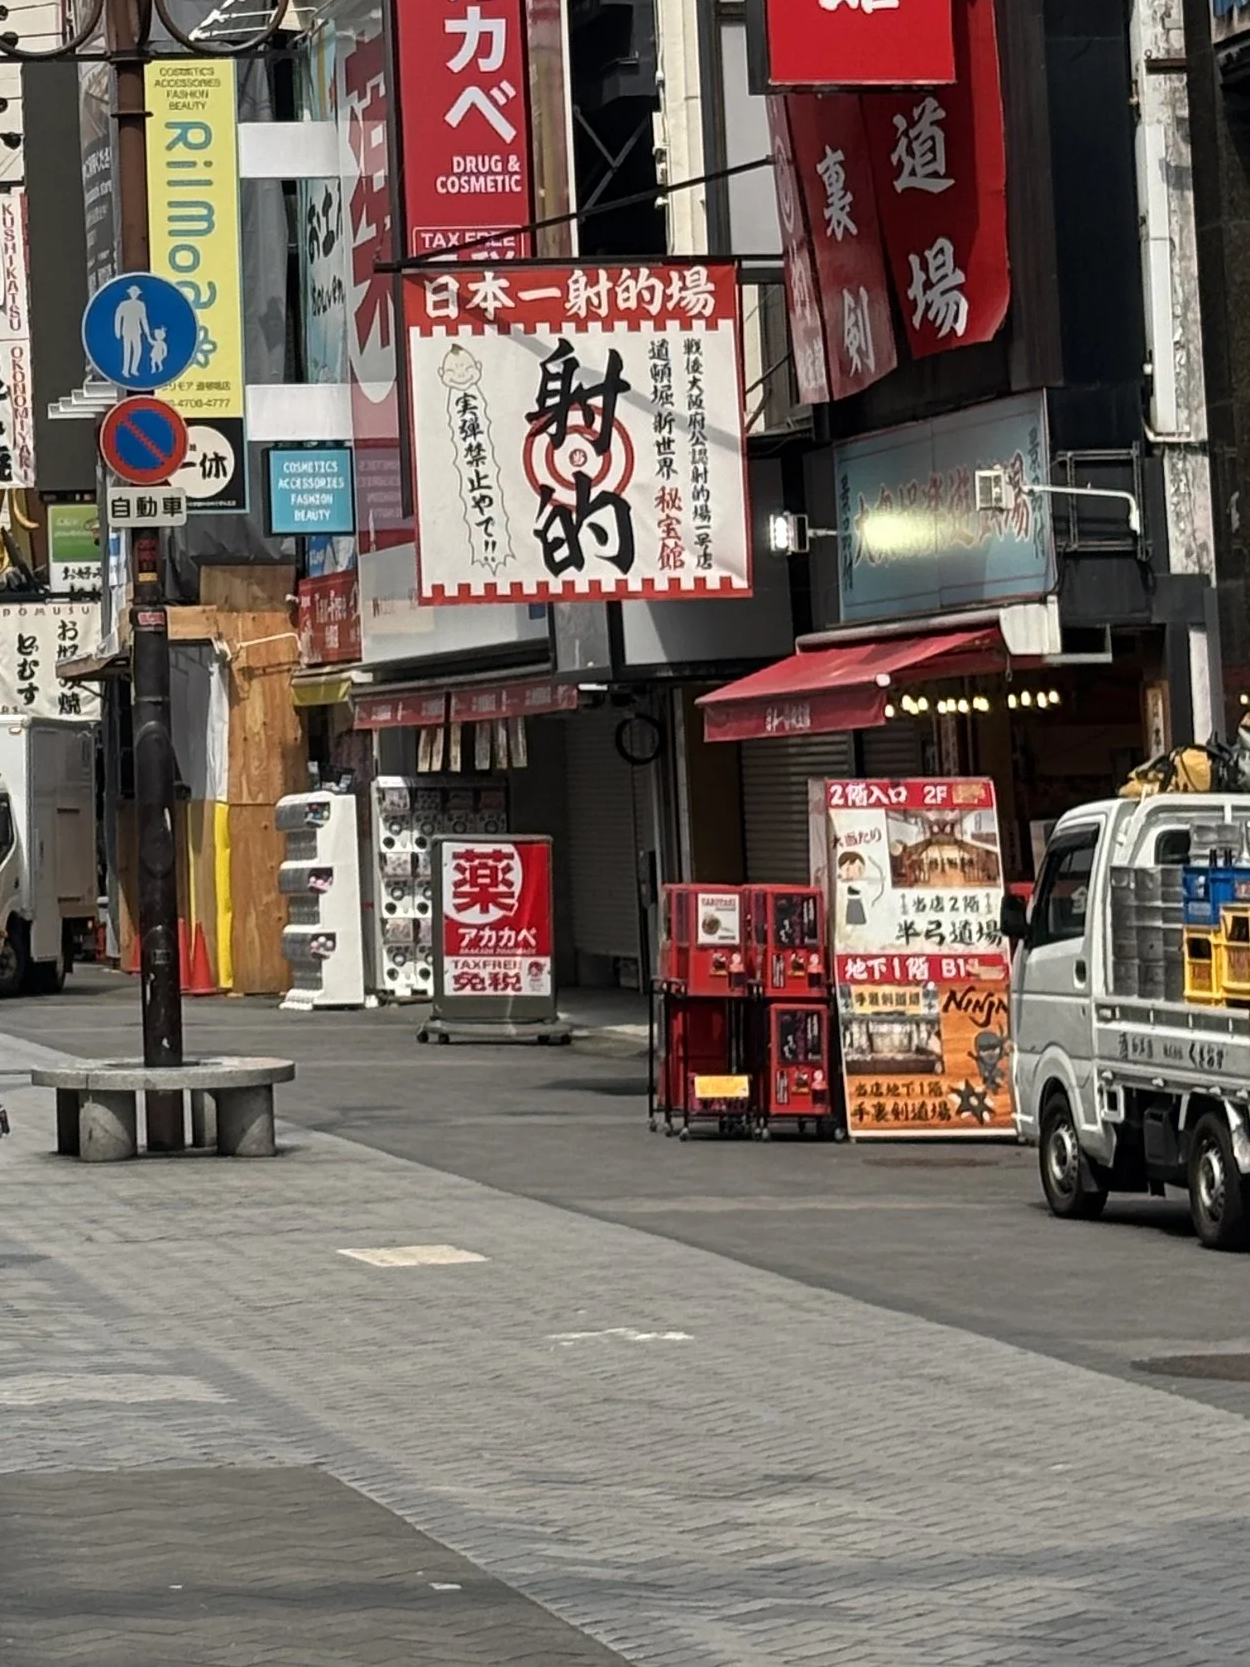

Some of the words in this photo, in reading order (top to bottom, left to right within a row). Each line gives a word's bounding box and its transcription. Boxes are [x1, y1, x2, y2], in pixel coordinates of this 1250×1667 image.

[166, 89, 209, 99] FASHION
[168, 101, 207, 110] BEAUTY
[452, 155, 502, 173] DRUG
[507, 154, 521, 172] &
[436, 174, 522, 194] COSMETIC
[890, 96, 969, 340] 道場
[421, 233, 460, 248] TAX
[2, 203, 21, 331] KUSHIKATSU
[423, 266, 717, 321] 日本一射的場
[10, 346, 31, 481] OKONOMIYAKI
[283, 460, 338, 473] COSMETICS
[525, 337, 636, 578] 射的
[278, 477, 344, 489] ACCESSORIES
[110, 496, 184, 518] 自動車
[291, 493, 333, 506] FASHION
[294, 509, 331, 521] BEAUTY
[654, 485, 686, 572] 秘宝館
[16, 633, 40, 706] どむす
[830, 782, 908, 806] 2階入口
[923, 785, 948, 805] 2F
[452, 848, 516, 914] 薬
[458, 925, 538, 947] アカカベ
[452, 971, 523, 992] 免税
